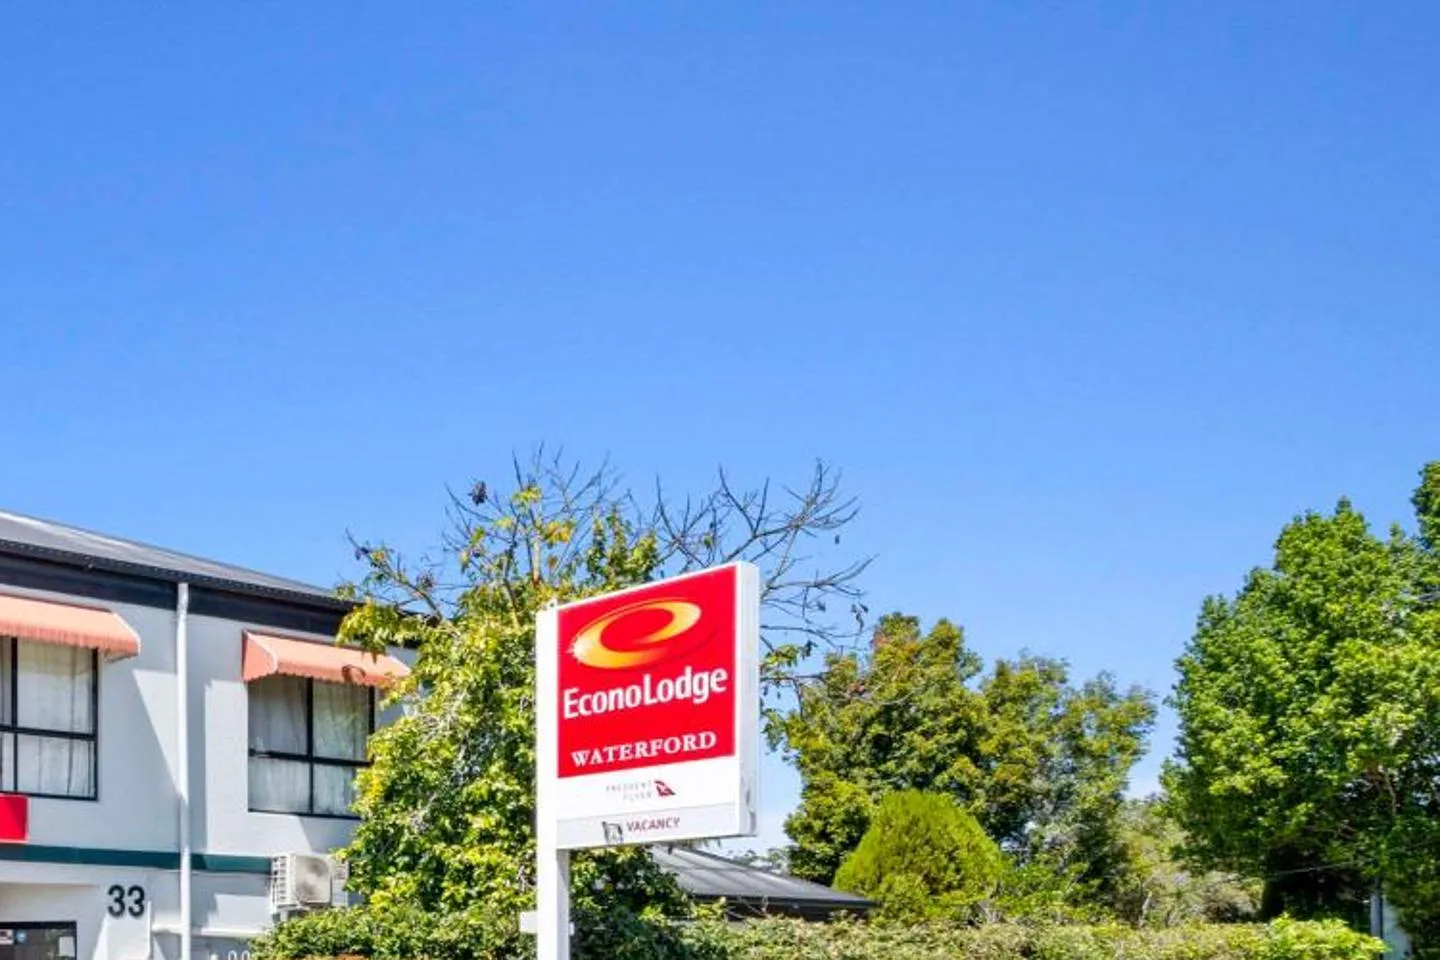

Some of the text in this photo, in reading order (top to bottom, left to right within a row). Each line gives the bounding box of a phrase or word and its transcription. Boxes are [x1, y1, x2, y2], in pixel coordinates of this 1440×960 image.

[563, 665, 729, 720] EconoLodge
[570, 730, 717, 768] WATERFORD
[626, 816, 680, 832] VACANCY
[107, 884, 145, 918] 33
